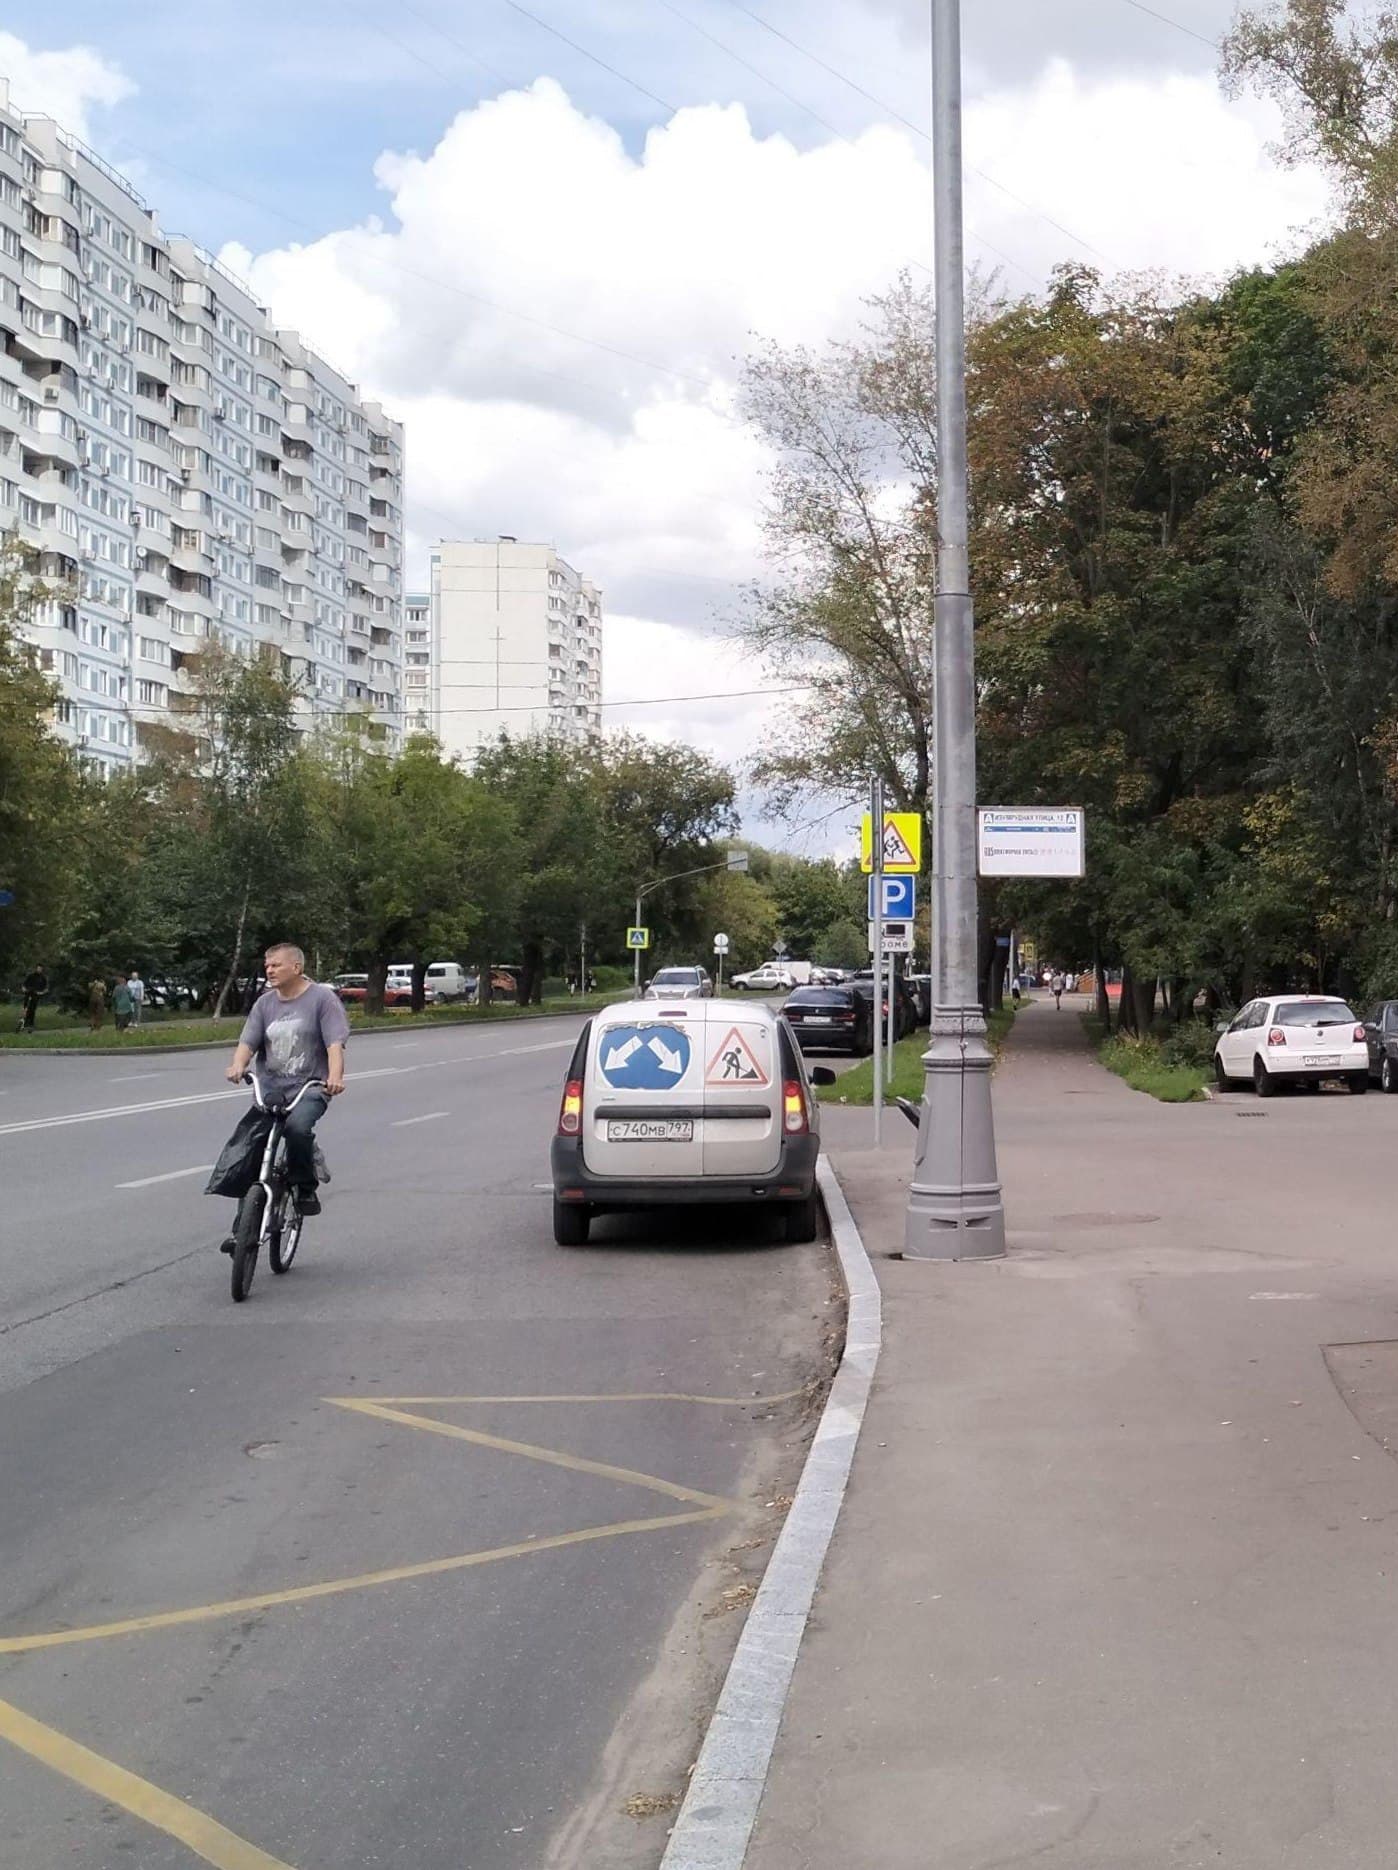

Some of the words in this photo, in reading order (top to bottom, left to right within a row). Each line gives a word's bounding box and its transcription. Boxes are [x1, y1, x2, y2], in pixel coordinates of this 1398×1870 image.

[881, 879, 906, 915] P
[613, 1123, 666, 1136] С740МВ
[668, 1122, 689, 1133] 797
